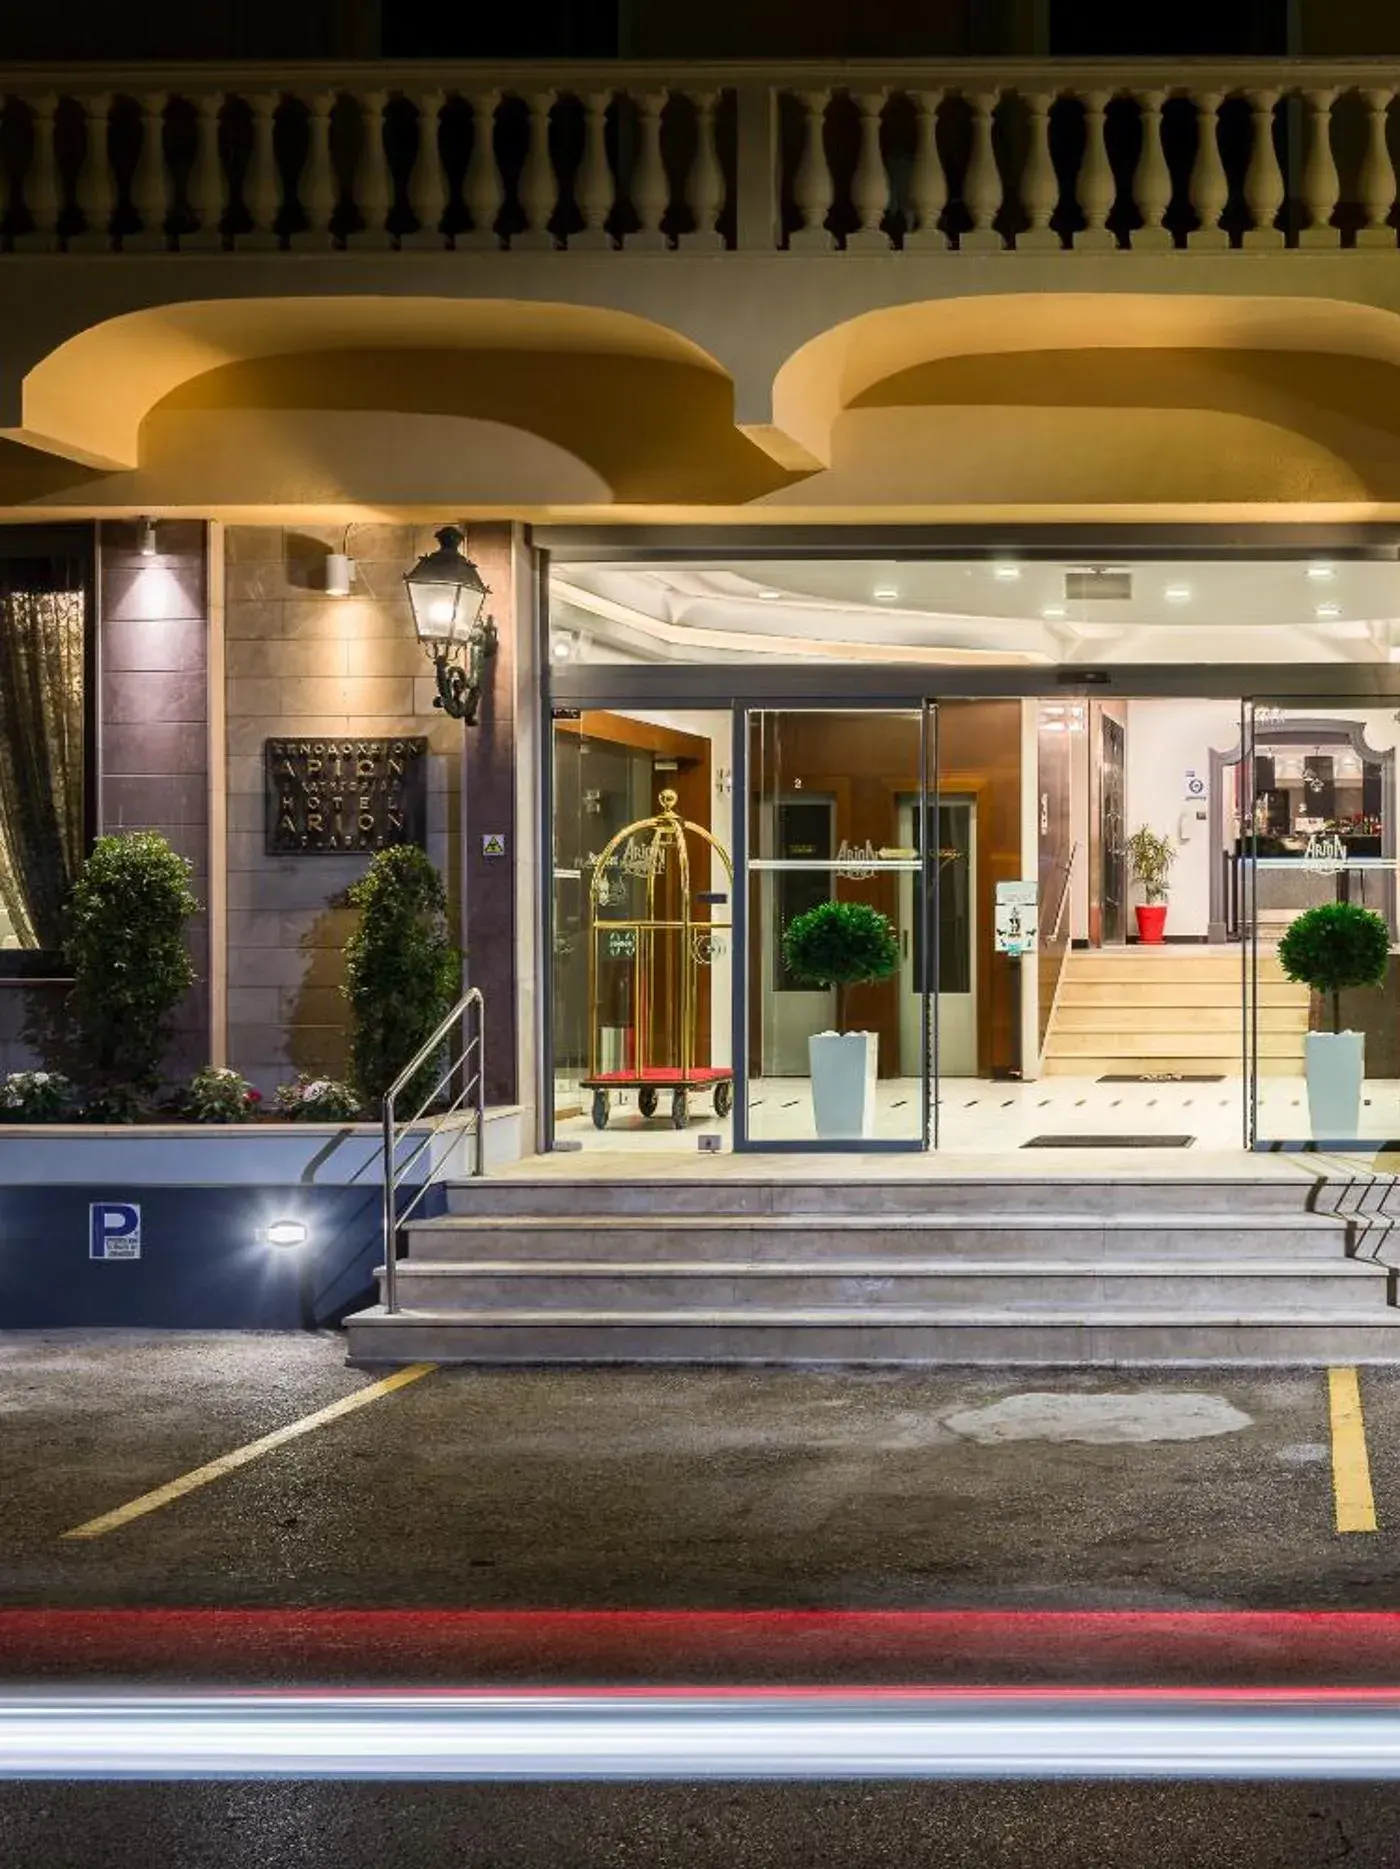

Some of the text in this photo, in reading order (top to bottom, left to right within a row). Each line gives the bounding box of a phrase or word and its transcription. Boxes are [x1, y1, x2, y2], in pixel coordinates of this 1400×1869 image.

[282, 795, 398, 810] HOTEL
[281, 813, 404, 833] ARION
[92, 1204, 139, 1257] P
